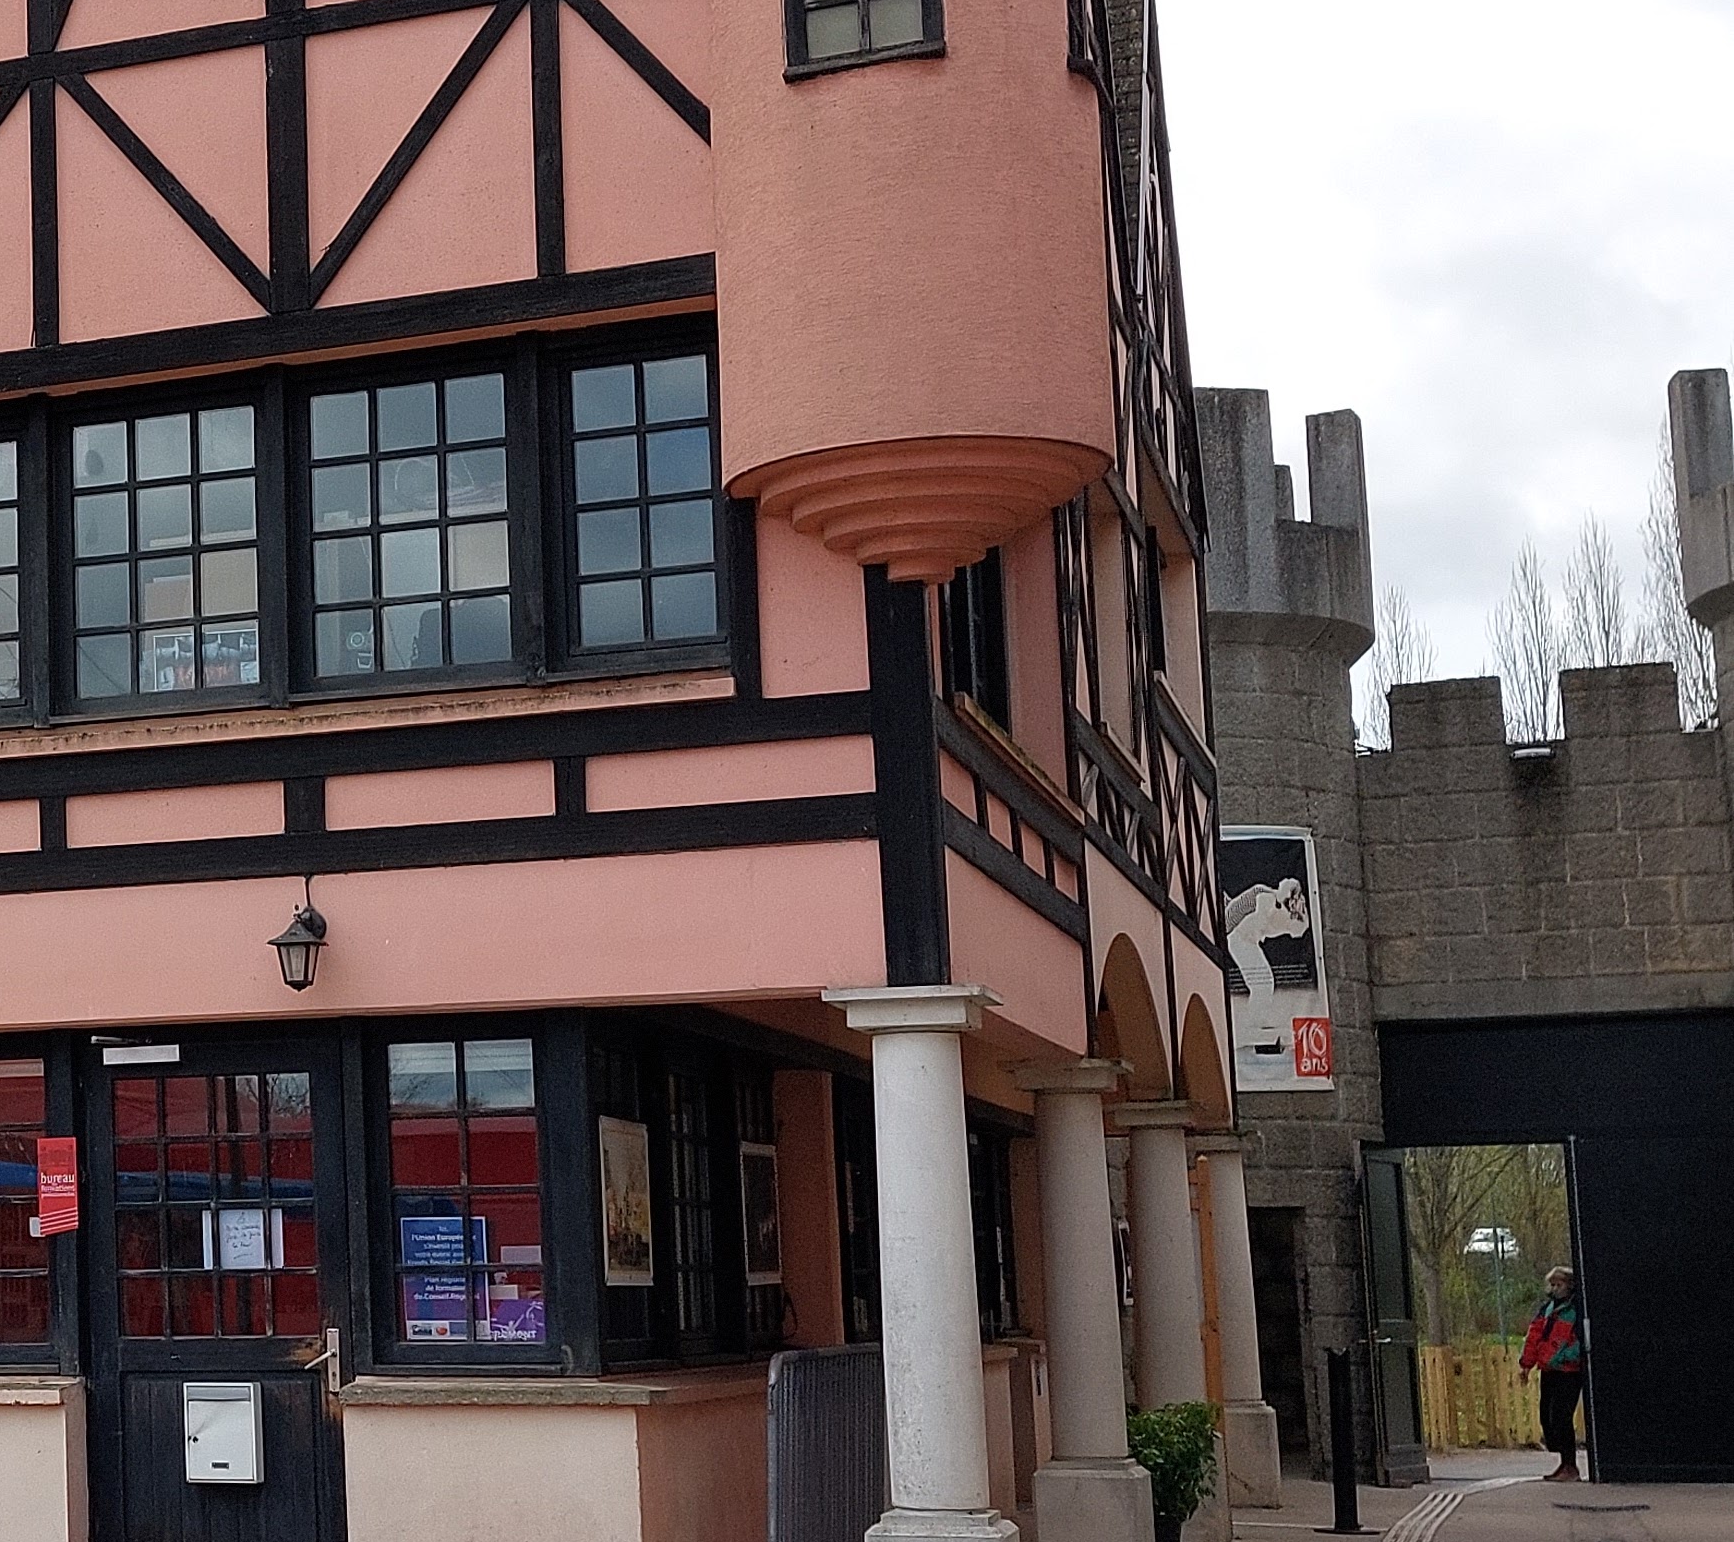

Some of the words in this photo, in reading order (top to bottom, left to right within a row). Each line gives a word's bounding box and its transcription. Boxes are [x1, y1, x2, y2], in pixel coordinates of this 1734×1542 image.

[1298, 1021, 1327, 1058] 10
[1301, 1058, 1329, 1073] ans
[40, 1171, 75, 1184] bureau
